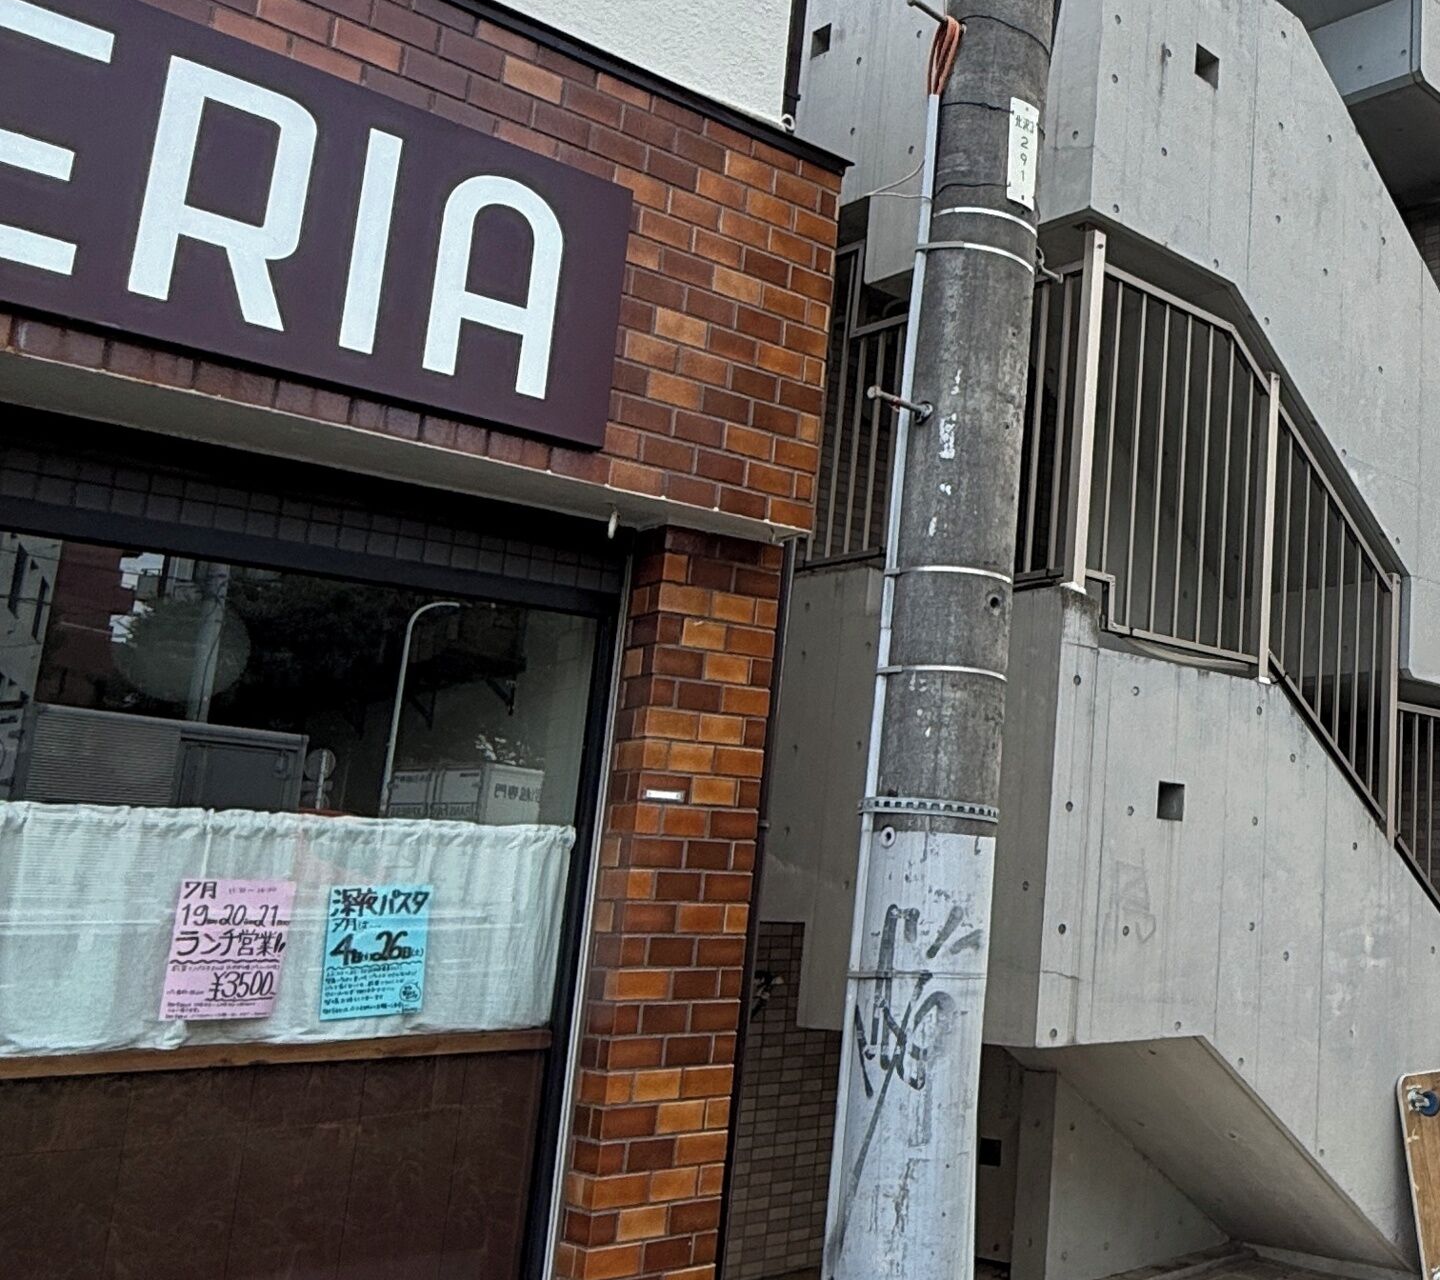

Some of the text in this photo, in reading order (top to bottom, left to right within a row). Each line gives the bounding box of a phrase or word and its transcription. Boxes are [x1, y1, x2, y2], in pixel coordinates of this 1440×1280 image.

[1020, 136, 1029, 182] 291
[183, 881, 218, 899] 7月
[330, 887, 430, 917] 深夜パスタ
